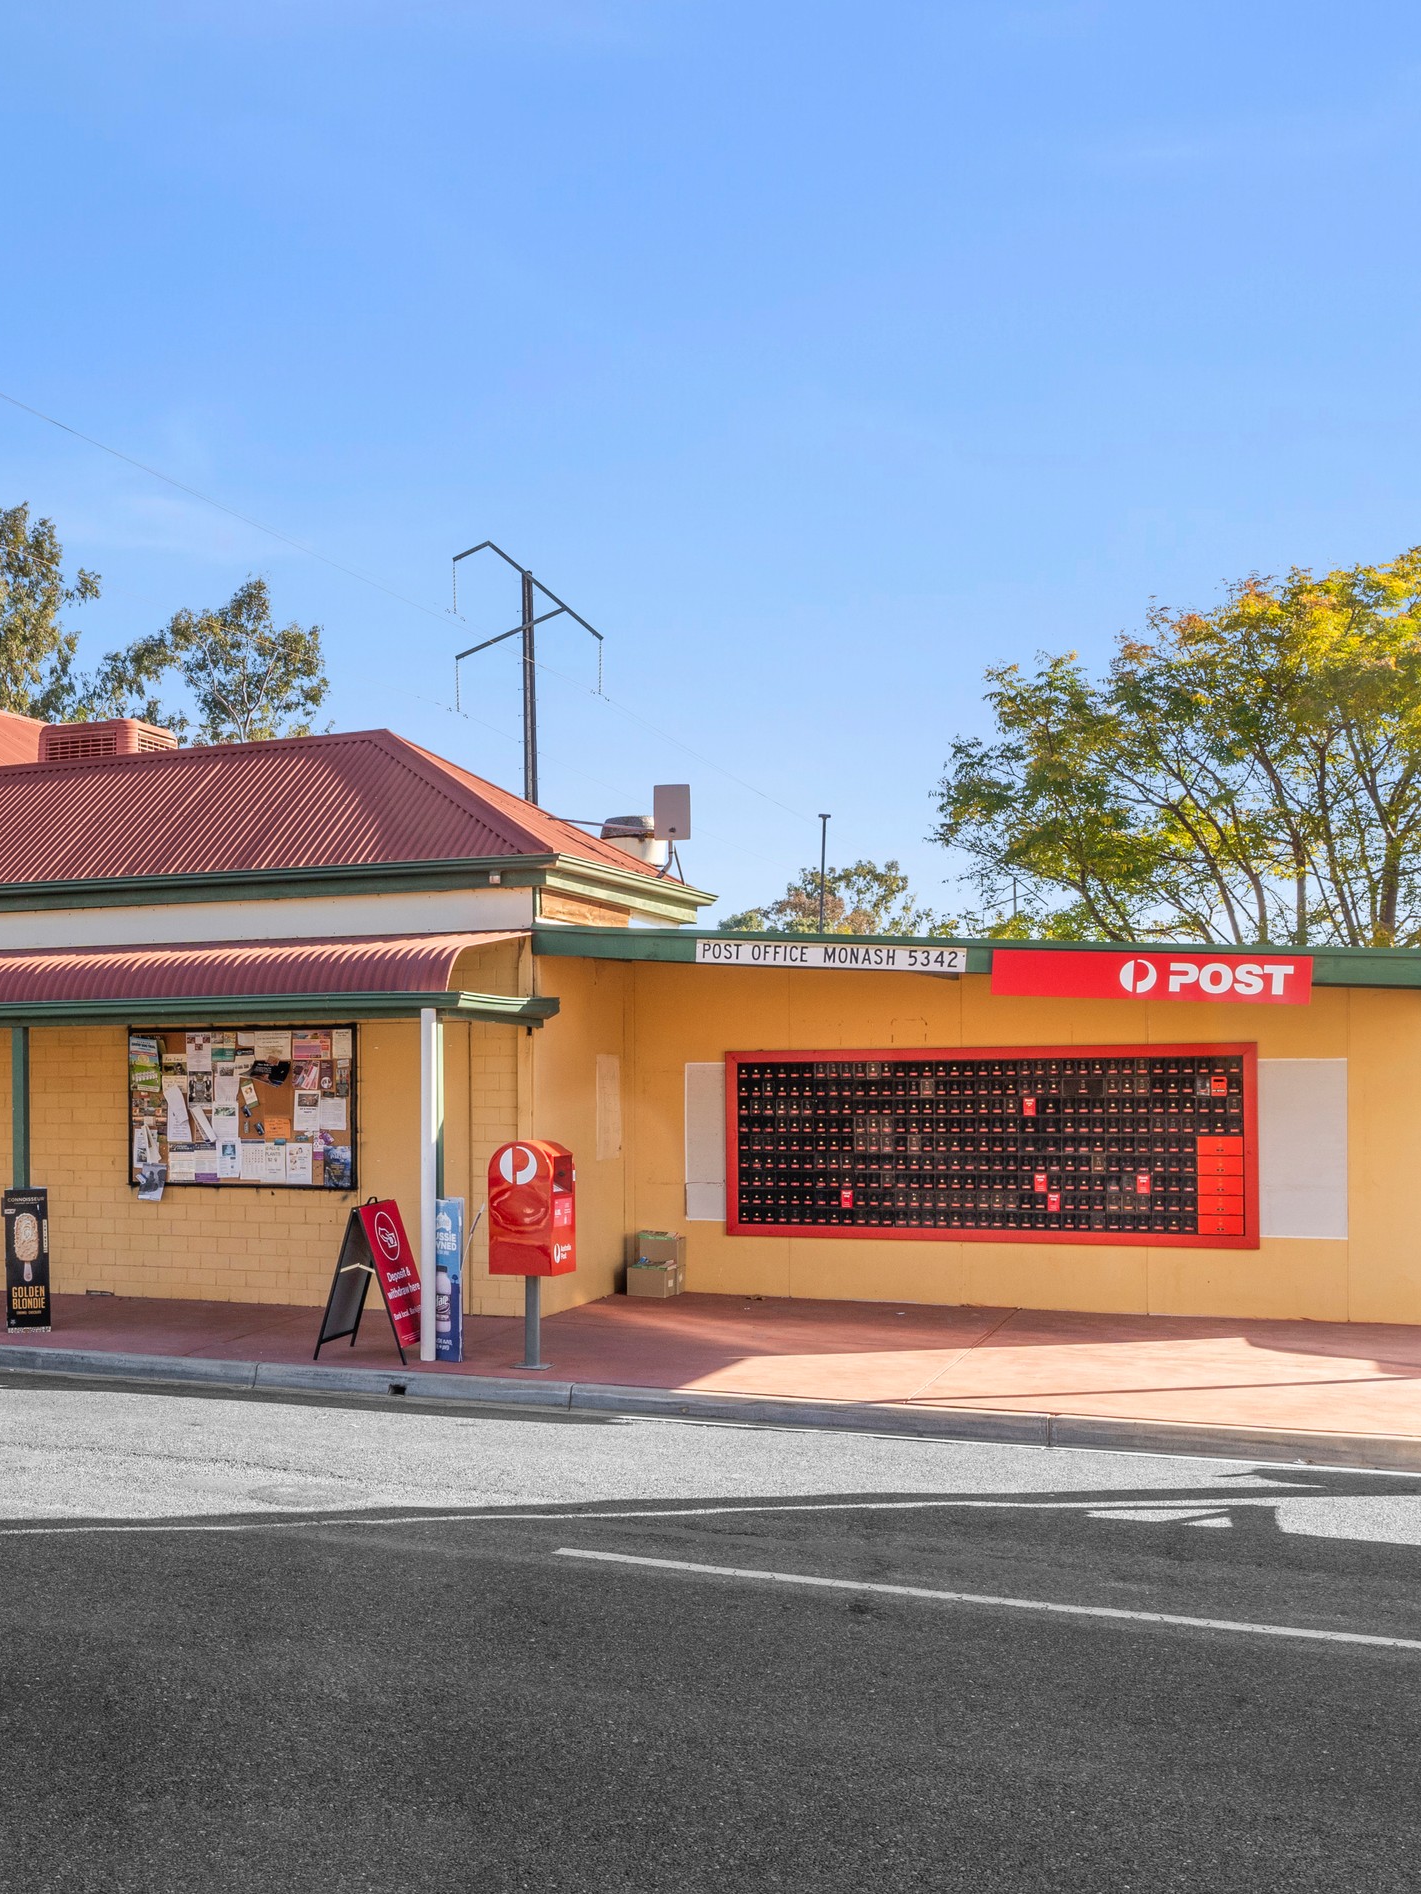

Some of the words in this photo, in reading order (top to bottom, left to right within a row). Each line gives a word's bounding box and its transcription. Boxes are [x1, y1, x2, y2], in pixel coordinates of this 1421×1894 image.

[701, 943, 742, 960] POST
[751, 945, 809, 963] OFFICE
[823, 947, 896, 966] MONASH
[907, 949, 959, 969] 5342
[1168, 962, 1295, 995] POST
[386, 1268, 407, 1283] Deposit
[406, 1266, 412, 1277] &
[12, 1286, 46, 1298] GOLDEN
[387, 1283, 410, 1300] withdraw
[408, 1282, 421, 1294] here
[12, 1297, 46, 1310] BLONDIE
